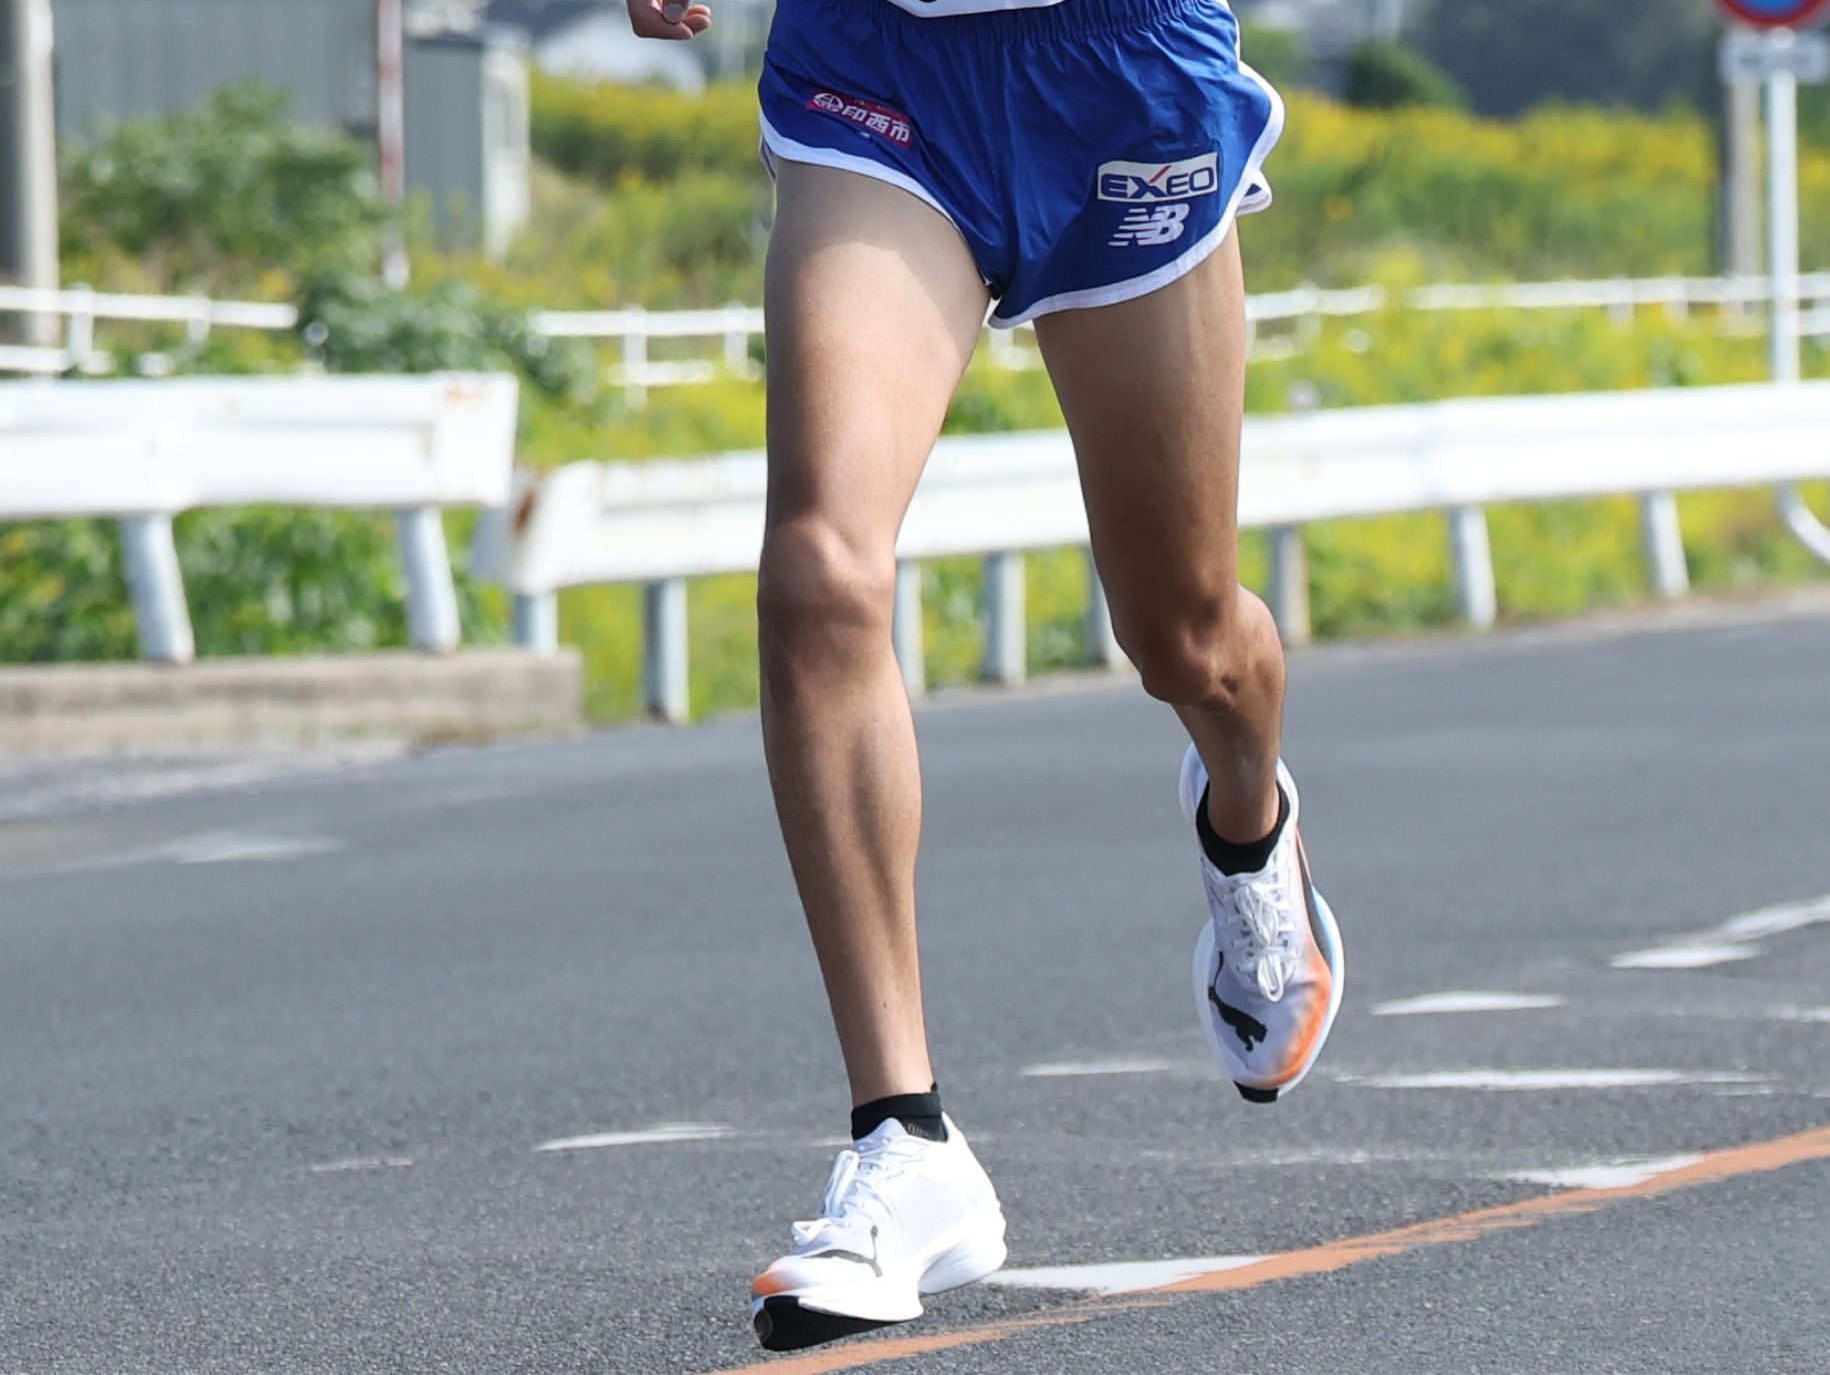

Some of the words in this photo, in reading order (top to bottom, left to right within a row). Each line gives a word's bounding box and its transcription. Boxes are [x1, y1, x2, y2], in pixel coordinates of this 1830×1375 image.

[841, 105, 911, 142] 印西市
[1101, 165, 1215, 199] EXEO
